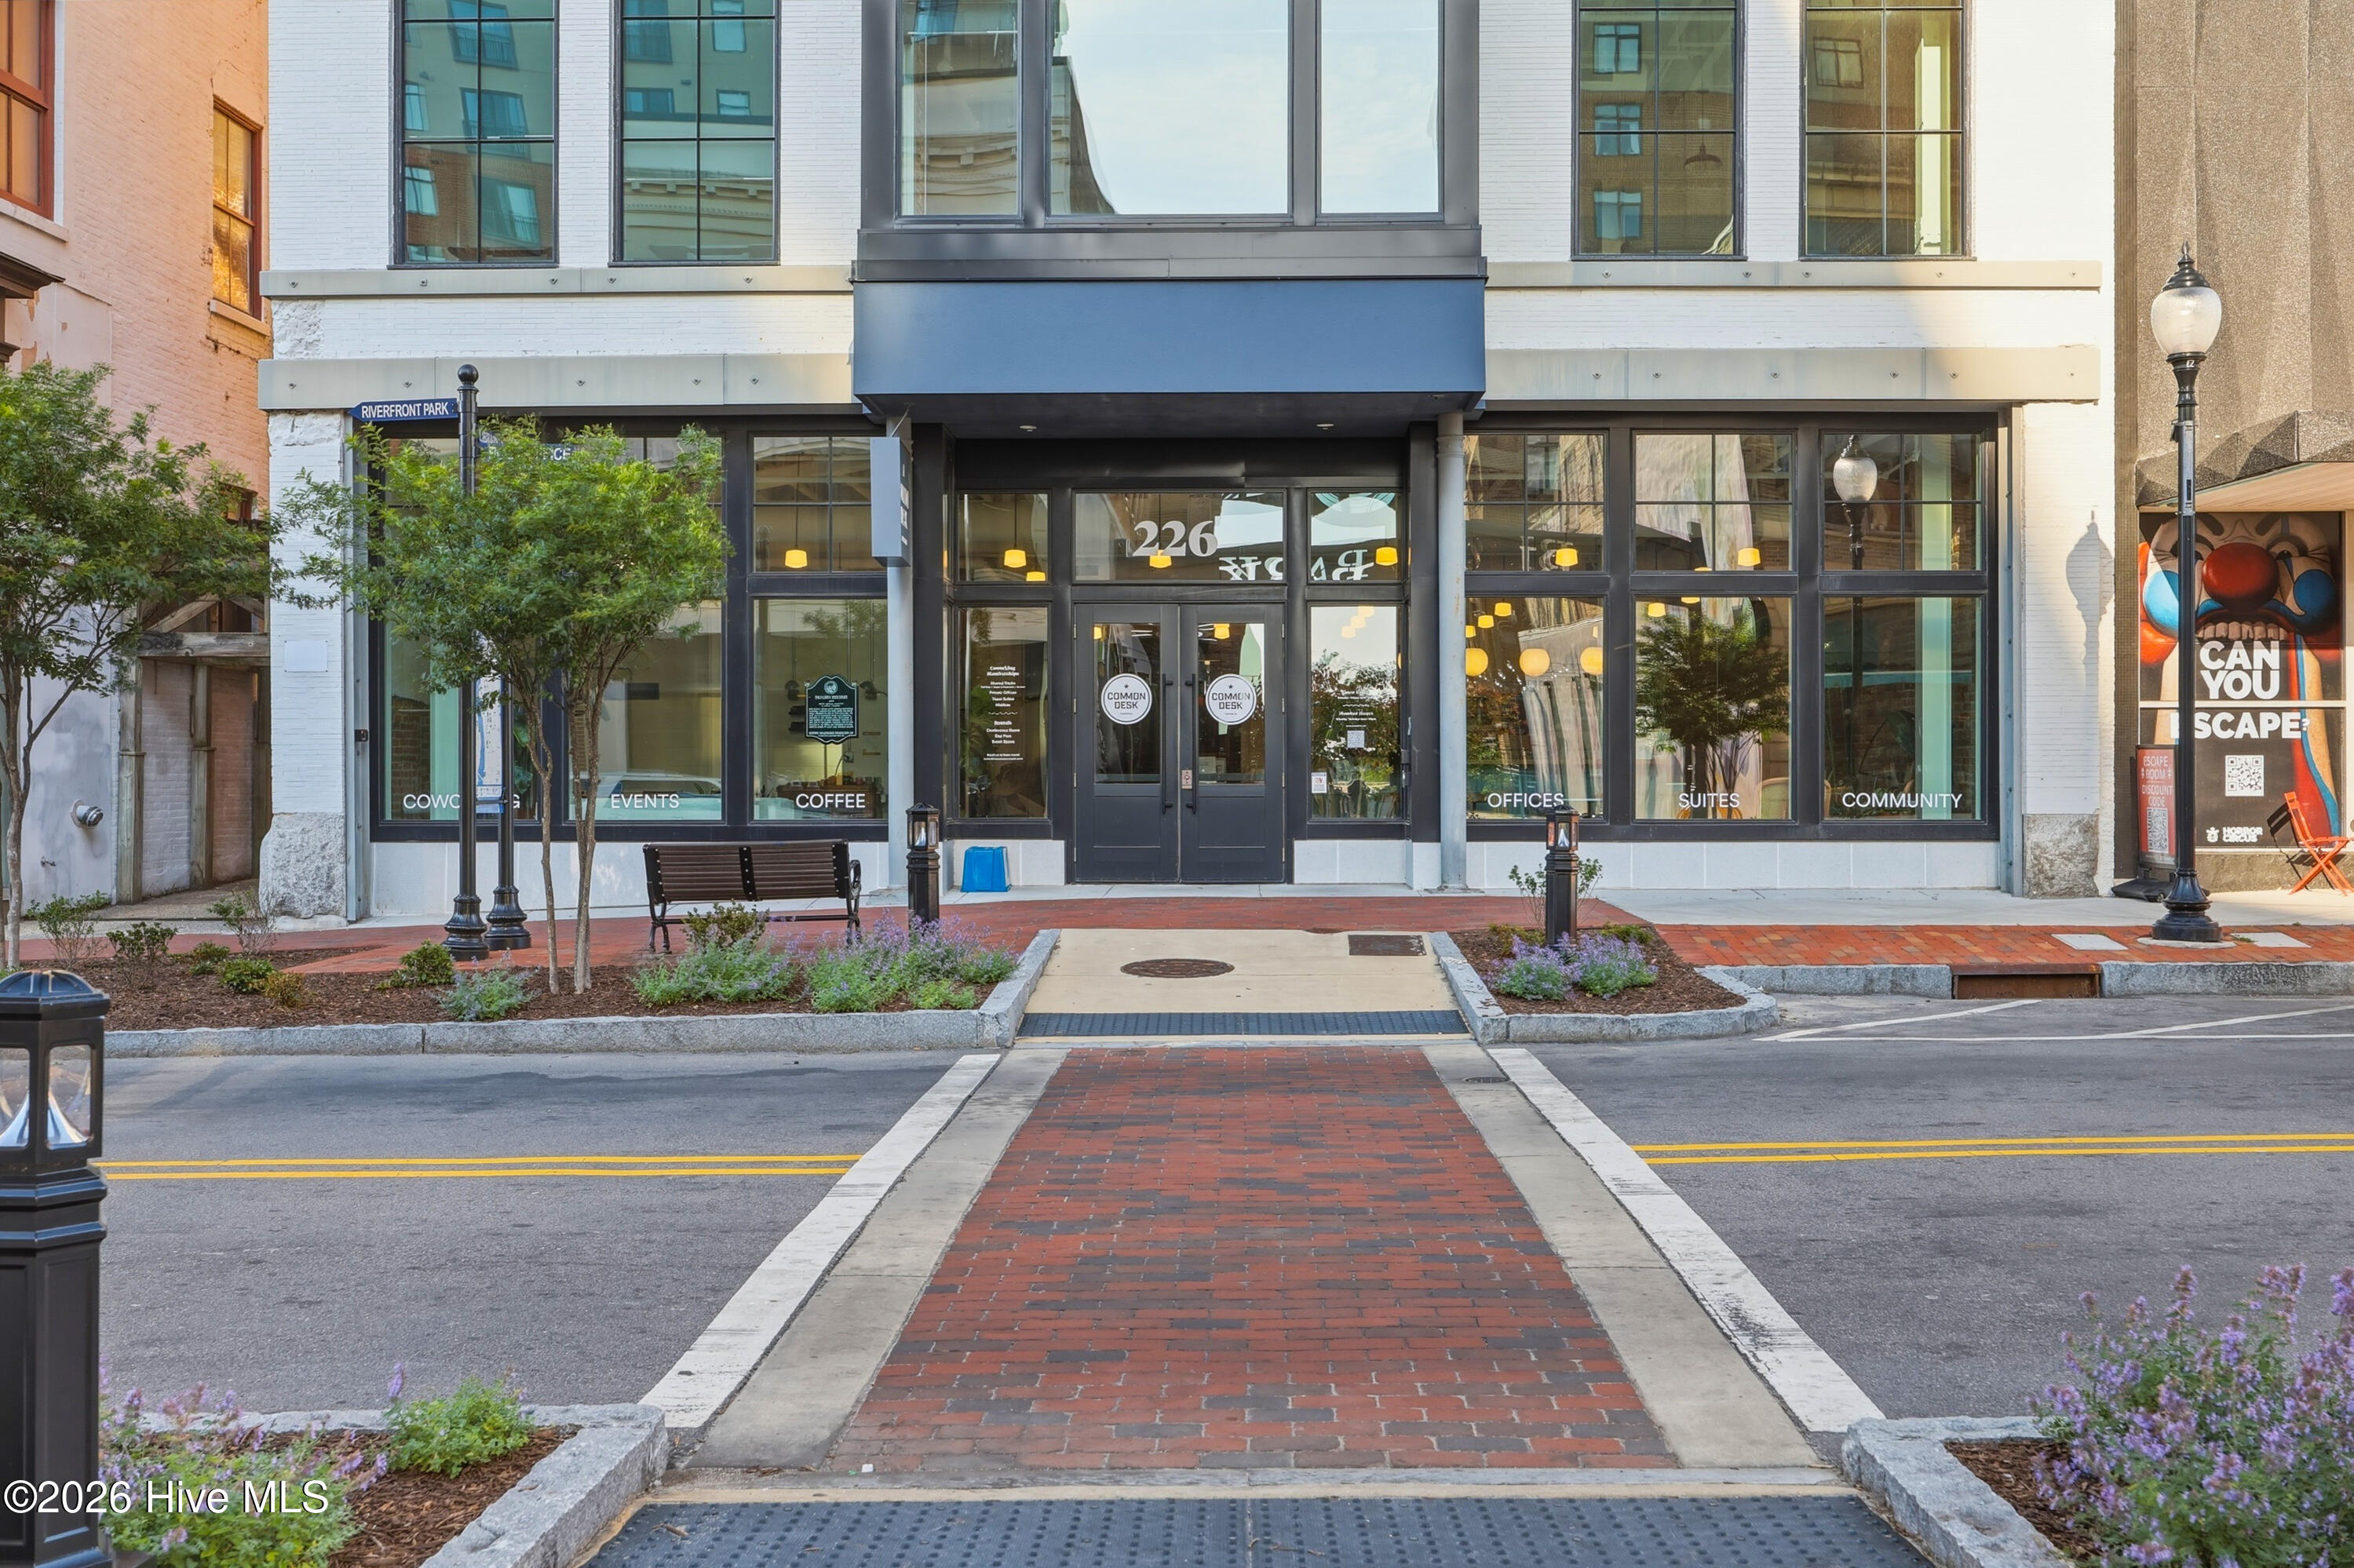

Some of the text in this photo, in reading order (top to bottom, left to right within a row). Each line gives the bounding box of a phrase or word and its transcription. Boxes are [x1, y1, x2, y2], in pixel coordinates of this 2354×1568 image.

[361, 401, 449, 419] RIVERFRONT PARK
[1133, 520, 1218, 557] 226
[2199, 640, 2280, 670] CAN
[2199, 669, 2280, 700] YOU
[1108, 691, 1146, 700] COMMON
[1211, 692, 1250, 701] COMMON
[1115, 701, 1138, 709] DESK
[1219, 701, 1243, 709] DESK
[2145, 768, 2166, 779] ROOM
[2142, 785, 2173, 795] DISCOUNT
[611, 793, 680, 809] EVENTS
[796, 793, 866, 808] COFFEE
[1487, 793, 1564, 808] OFFICES
[1678, 793, 1740, 808] SUITES
[1841, 792, 1962, 808] COMMUNITY
[2148, 797, 2166, 807] CODE
[2222, 826, 2264, 836] HORROR
[2222, 834, 2258, 843] CIRCUS
